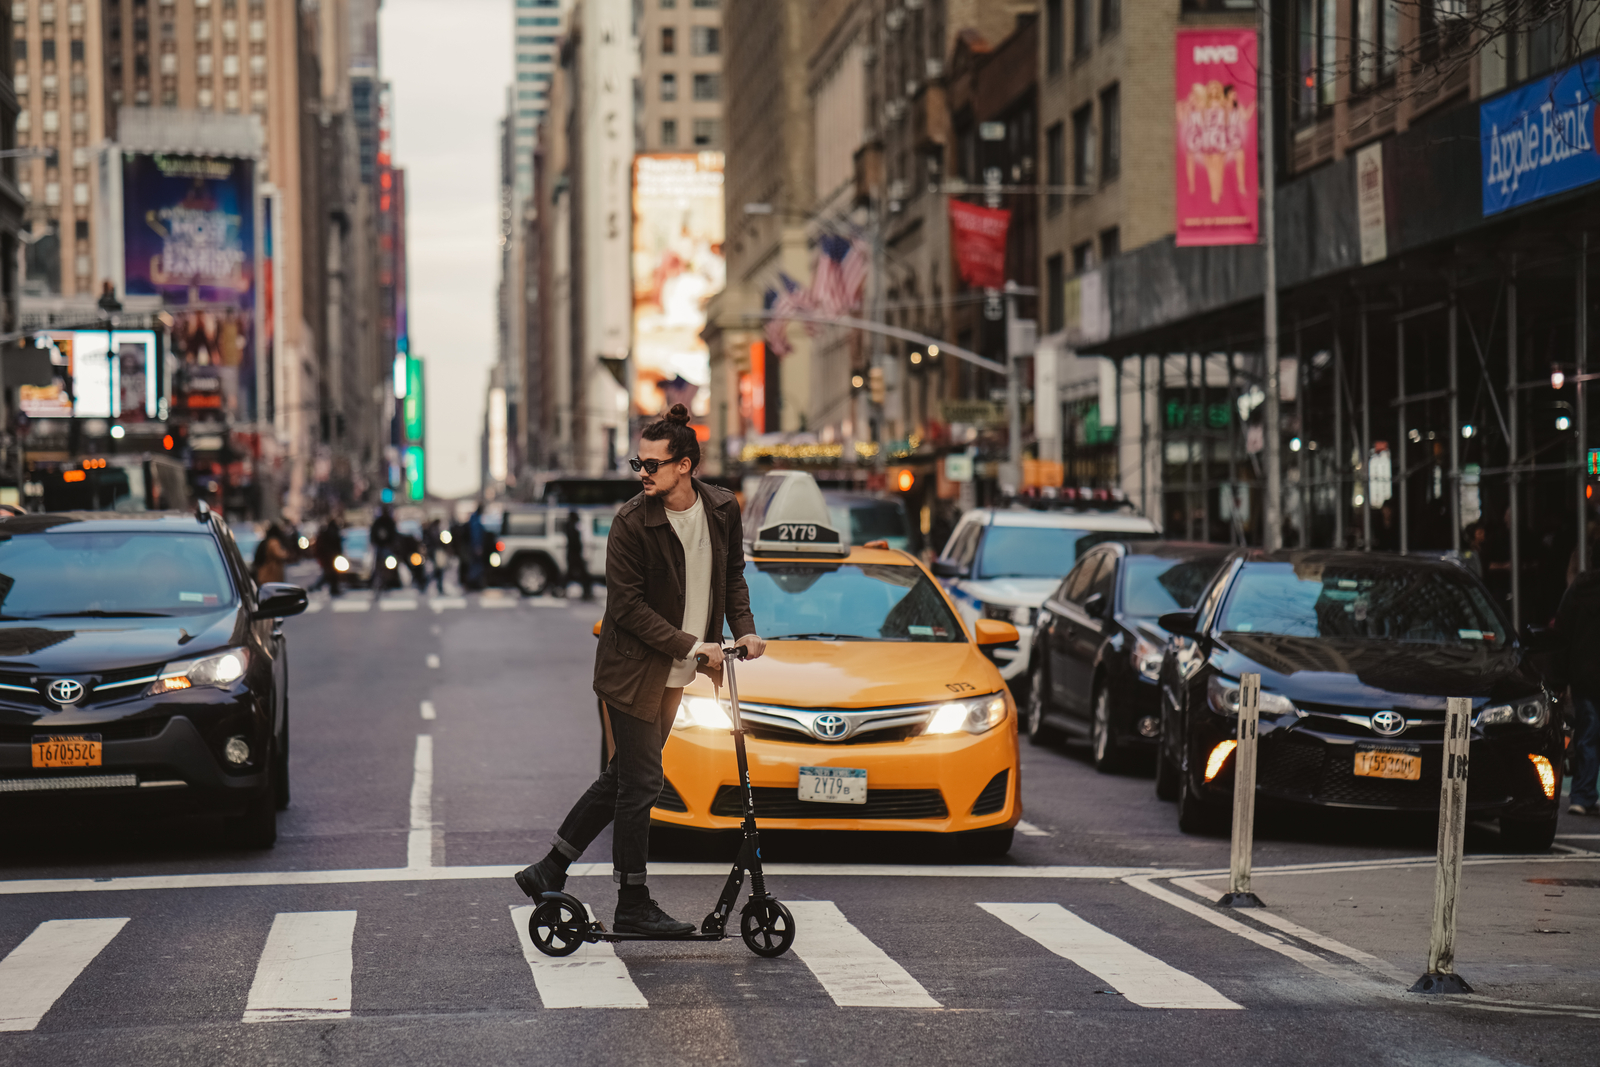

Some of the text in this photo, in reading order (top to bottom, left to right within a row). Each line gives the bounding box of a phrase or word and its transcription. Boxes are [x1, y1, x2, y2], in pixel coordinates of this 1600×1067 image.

[1193, 45, 1239, 65] NYC
[1488, 90, 1591, 195] Apple Bank
[779, 525, 817, 540] 2Y79
[945, 682, 976, 693] 073
[38, 743, 96, 761] T670552C
